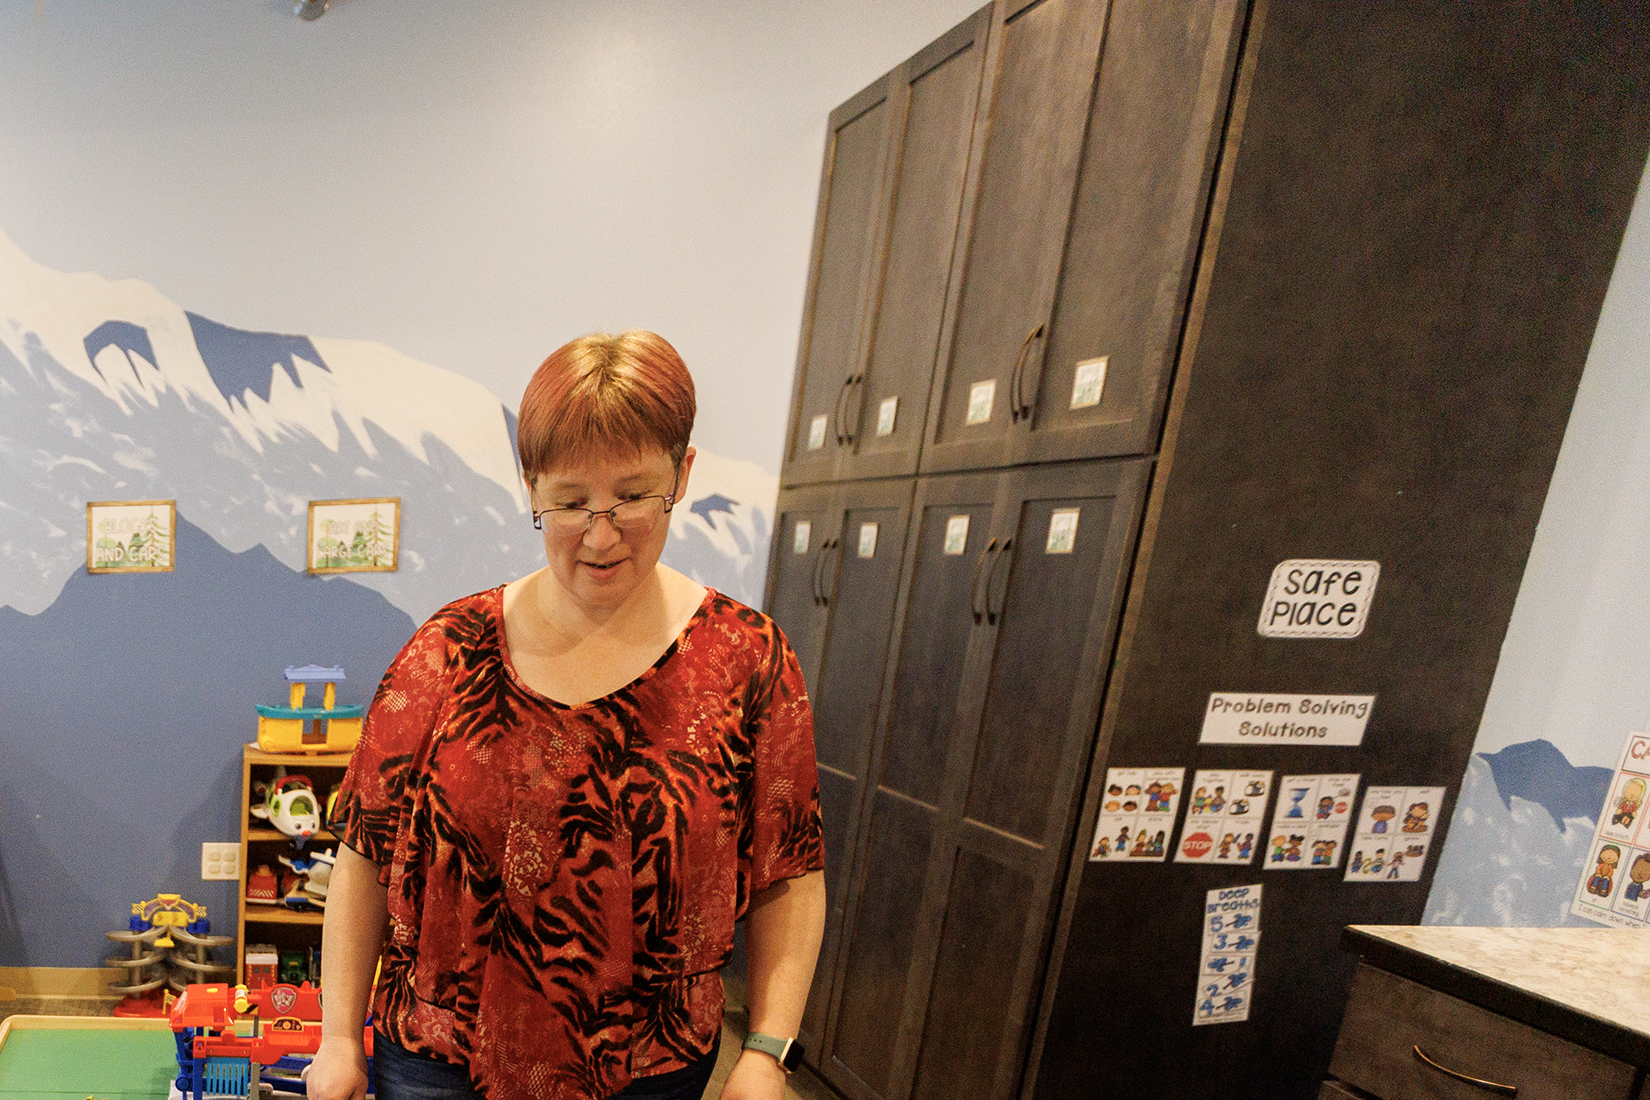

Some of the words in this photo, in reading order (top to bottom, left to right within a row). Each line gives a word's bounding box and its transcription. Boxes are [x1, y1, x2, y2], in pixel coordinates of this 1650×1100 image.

[353, 519, 379, 534] AND
[96, 546, 125, 562] AND
[129, 545, 165, 562] CARS
[1210, 697, 1291, 714] Problem
[1298, 698, 1369, 719] Solving
[1238, 721, 1329, 738] Solutions
[1184, 840, 1212, 849] STOP
[1210, 916, 1224, 933] 5
[1213, 934, 1228, 950] 3
[1206, 984, 1222, 997] 2
[1200, 998, 1215, 1016] 4
